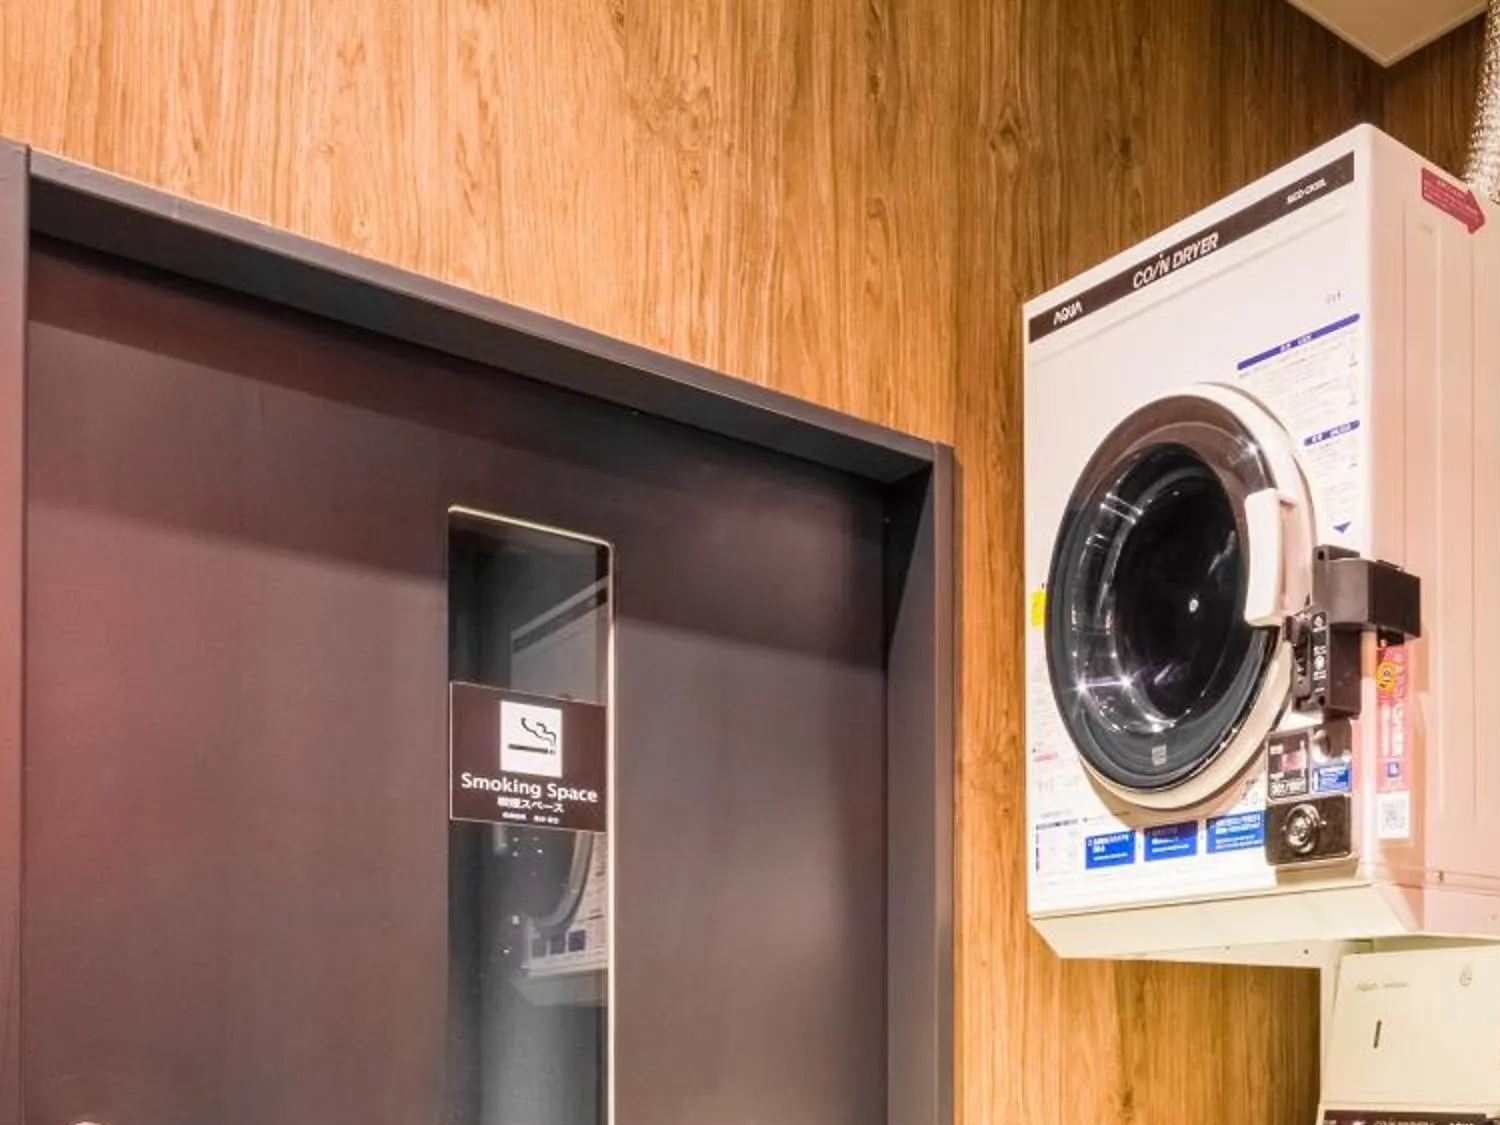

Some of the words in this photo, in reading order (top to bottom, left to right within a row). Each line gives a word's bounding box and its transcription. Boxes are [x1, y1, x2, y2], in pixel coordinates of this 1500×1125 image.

[1133, 253, 1171, 289] COIN
[1172, 232, 1219, 269] DRYER
[1053, 301, 1083, 326] AQUA
[461, 772, 541, 798] Smoking
[547, 783, 598, 803] Space
[497, 797, 564, 813] スペース
